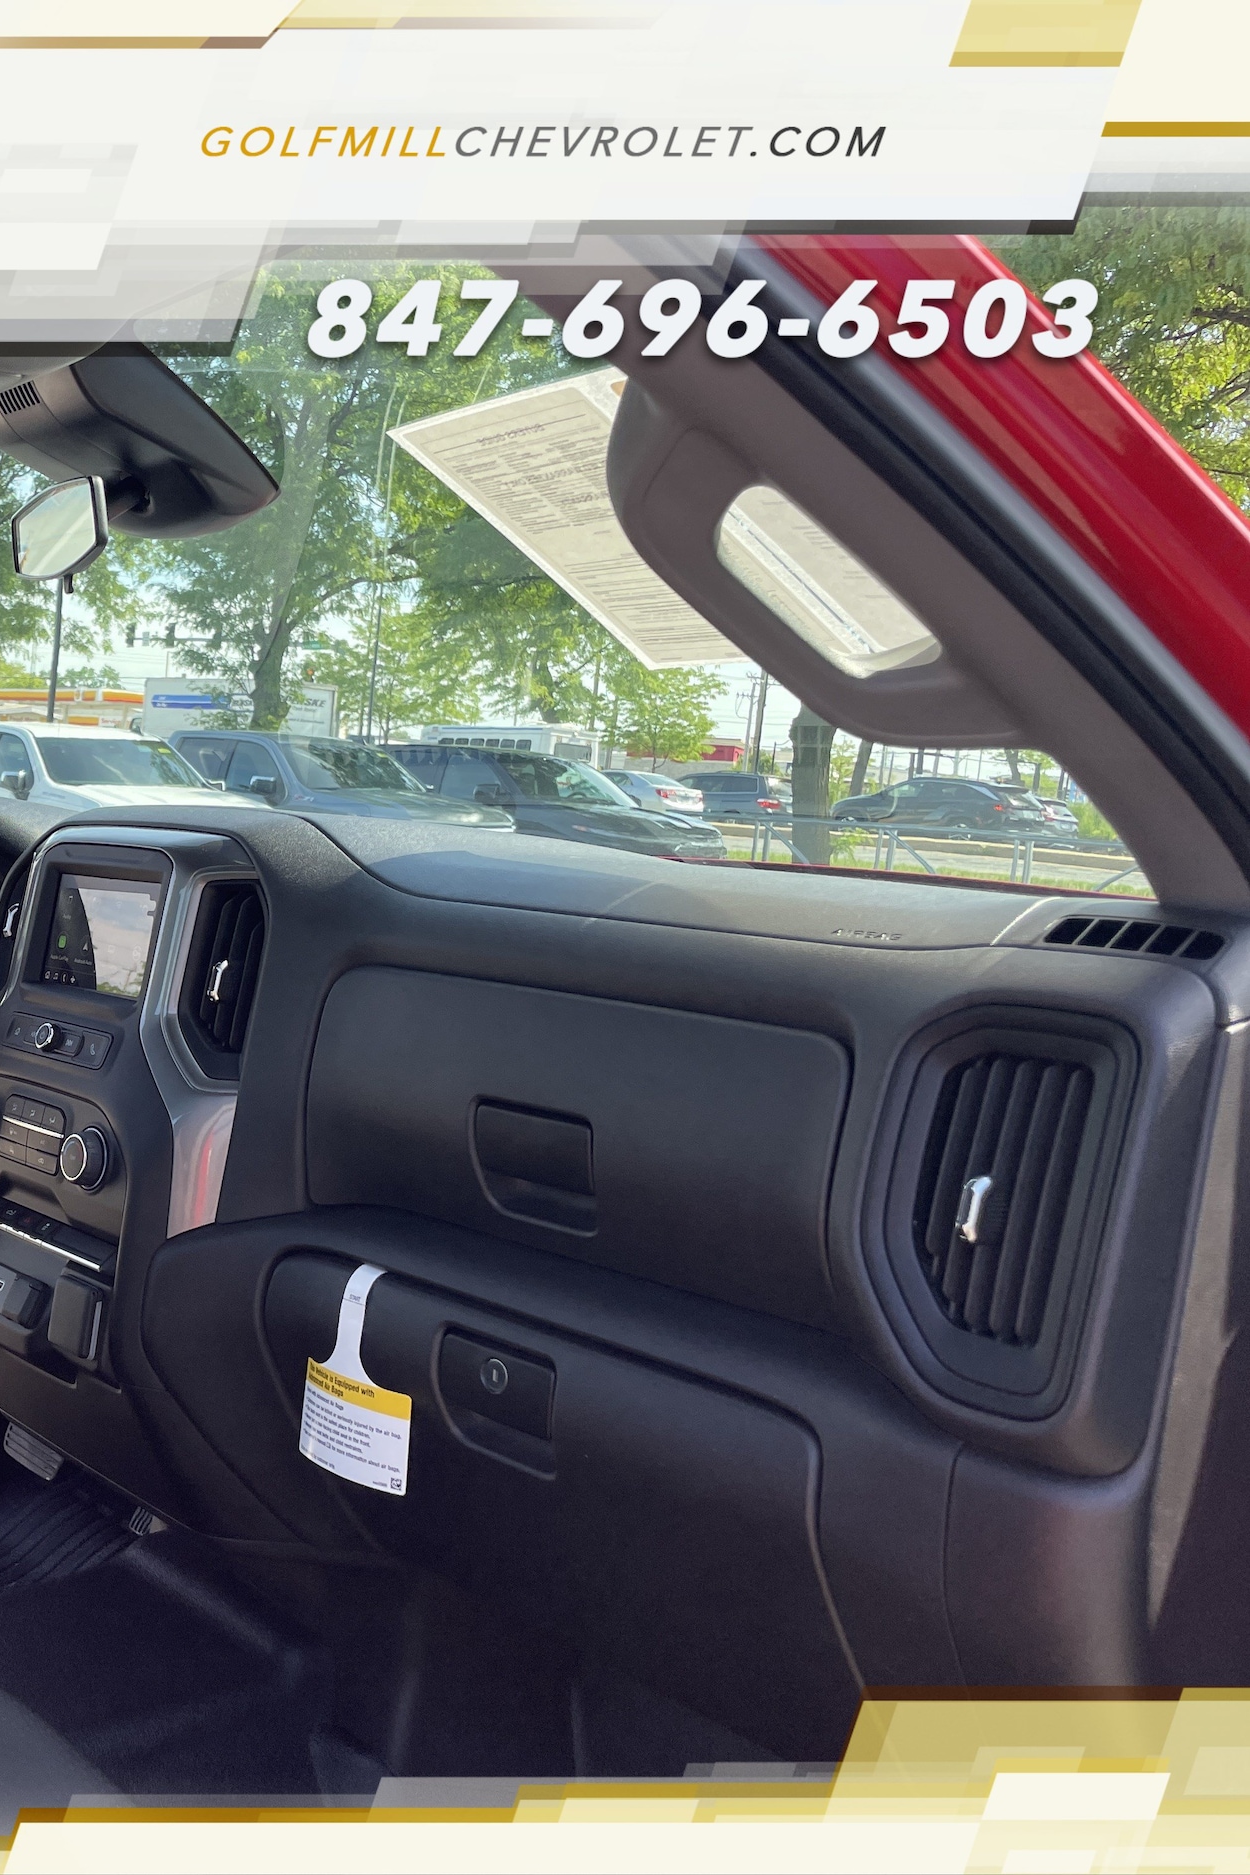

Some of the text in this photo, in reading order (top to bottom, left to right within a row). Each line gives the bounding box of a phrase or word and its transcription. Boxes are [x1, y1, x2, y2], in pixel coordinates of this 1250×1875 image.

[831, 927, 903, 941] AIRBAG
[316, 1366, 328, 1380] Vehicle
[334, 1376, 359, 1392] Equipped
[361, 1387, 375, 1398] with
[332, 1385, 344, 1397] Bags
[354, 1421, 368, 1430] injured
[346, 1452, 367, 1463] information
